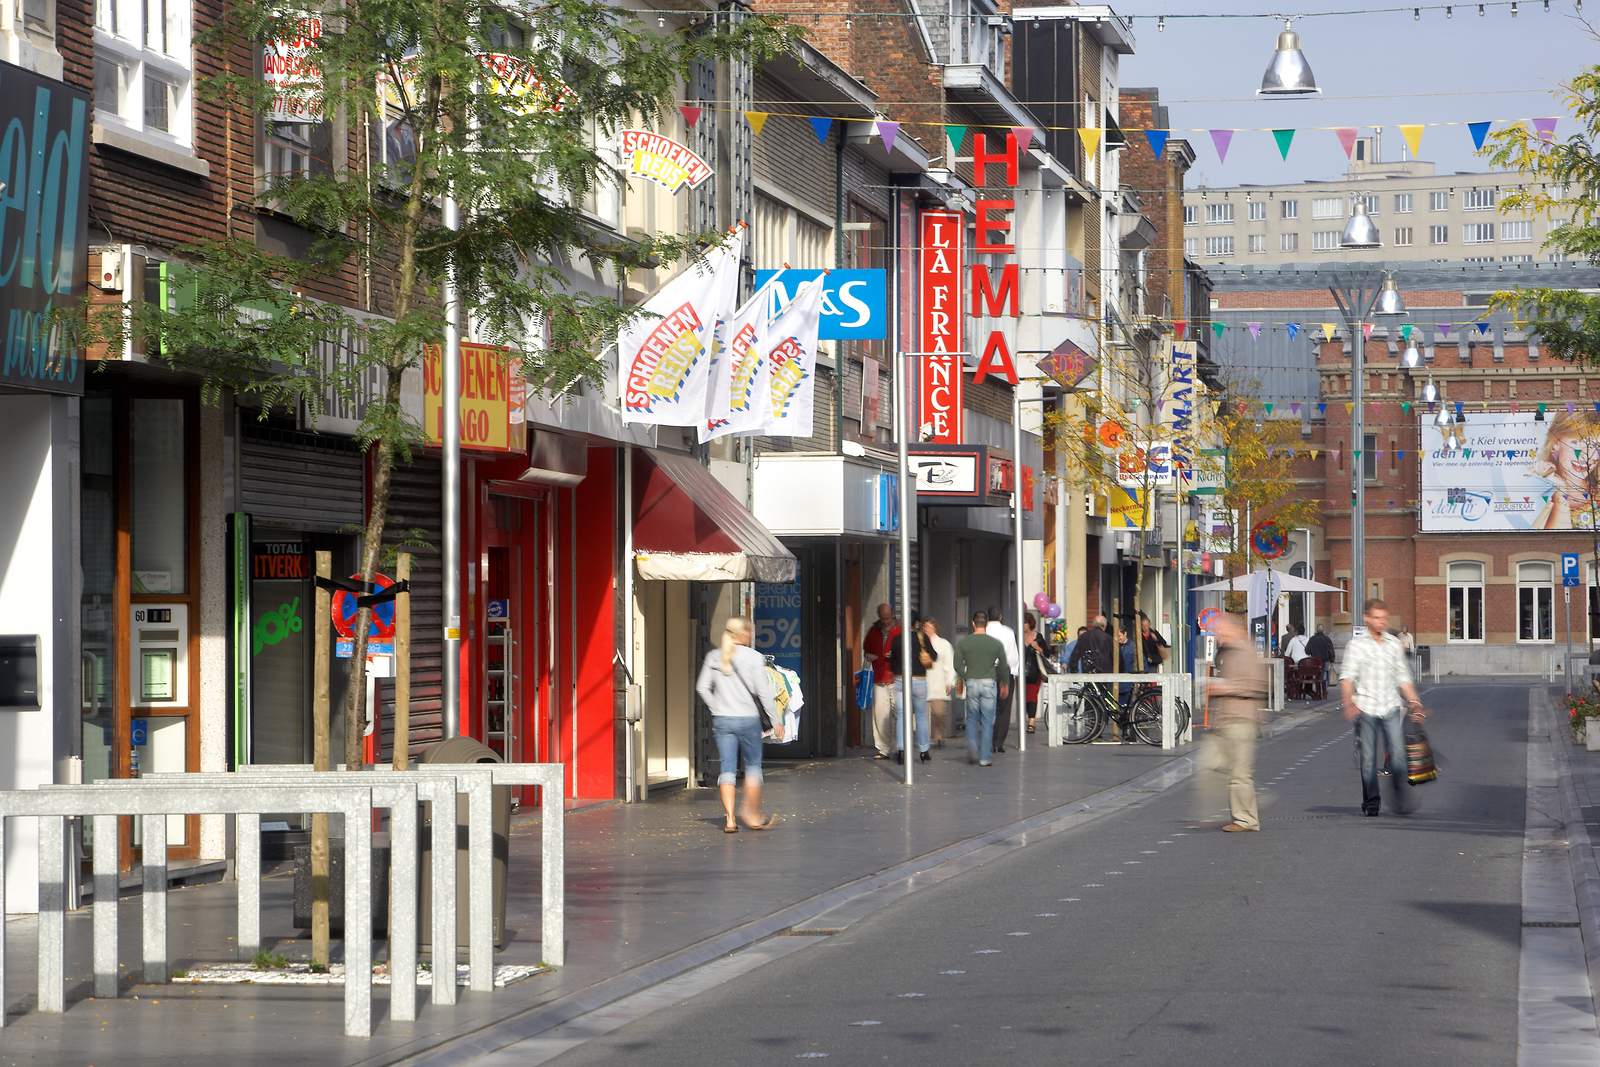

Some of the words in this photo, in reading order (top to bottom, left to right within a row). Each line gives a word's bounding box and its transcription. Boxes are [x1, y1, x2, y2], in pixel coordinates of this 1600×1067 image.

[626, 132, 709, 184] SCHOENEN
[640, 152, 681, 186] REUS
[930, 223, 951, 274] LA
[972, 132, 1019, 385] HEMA
[769, 280, 871, 328] M&S
[626, 306, 698, 405] SCHOENEN
[653, 338, 696, 390] REUS
[930, 285, 951, 438] FRANCE
[1478, 436, 1496, 445] Kiel
[1564, 557, 1576, 574] P
